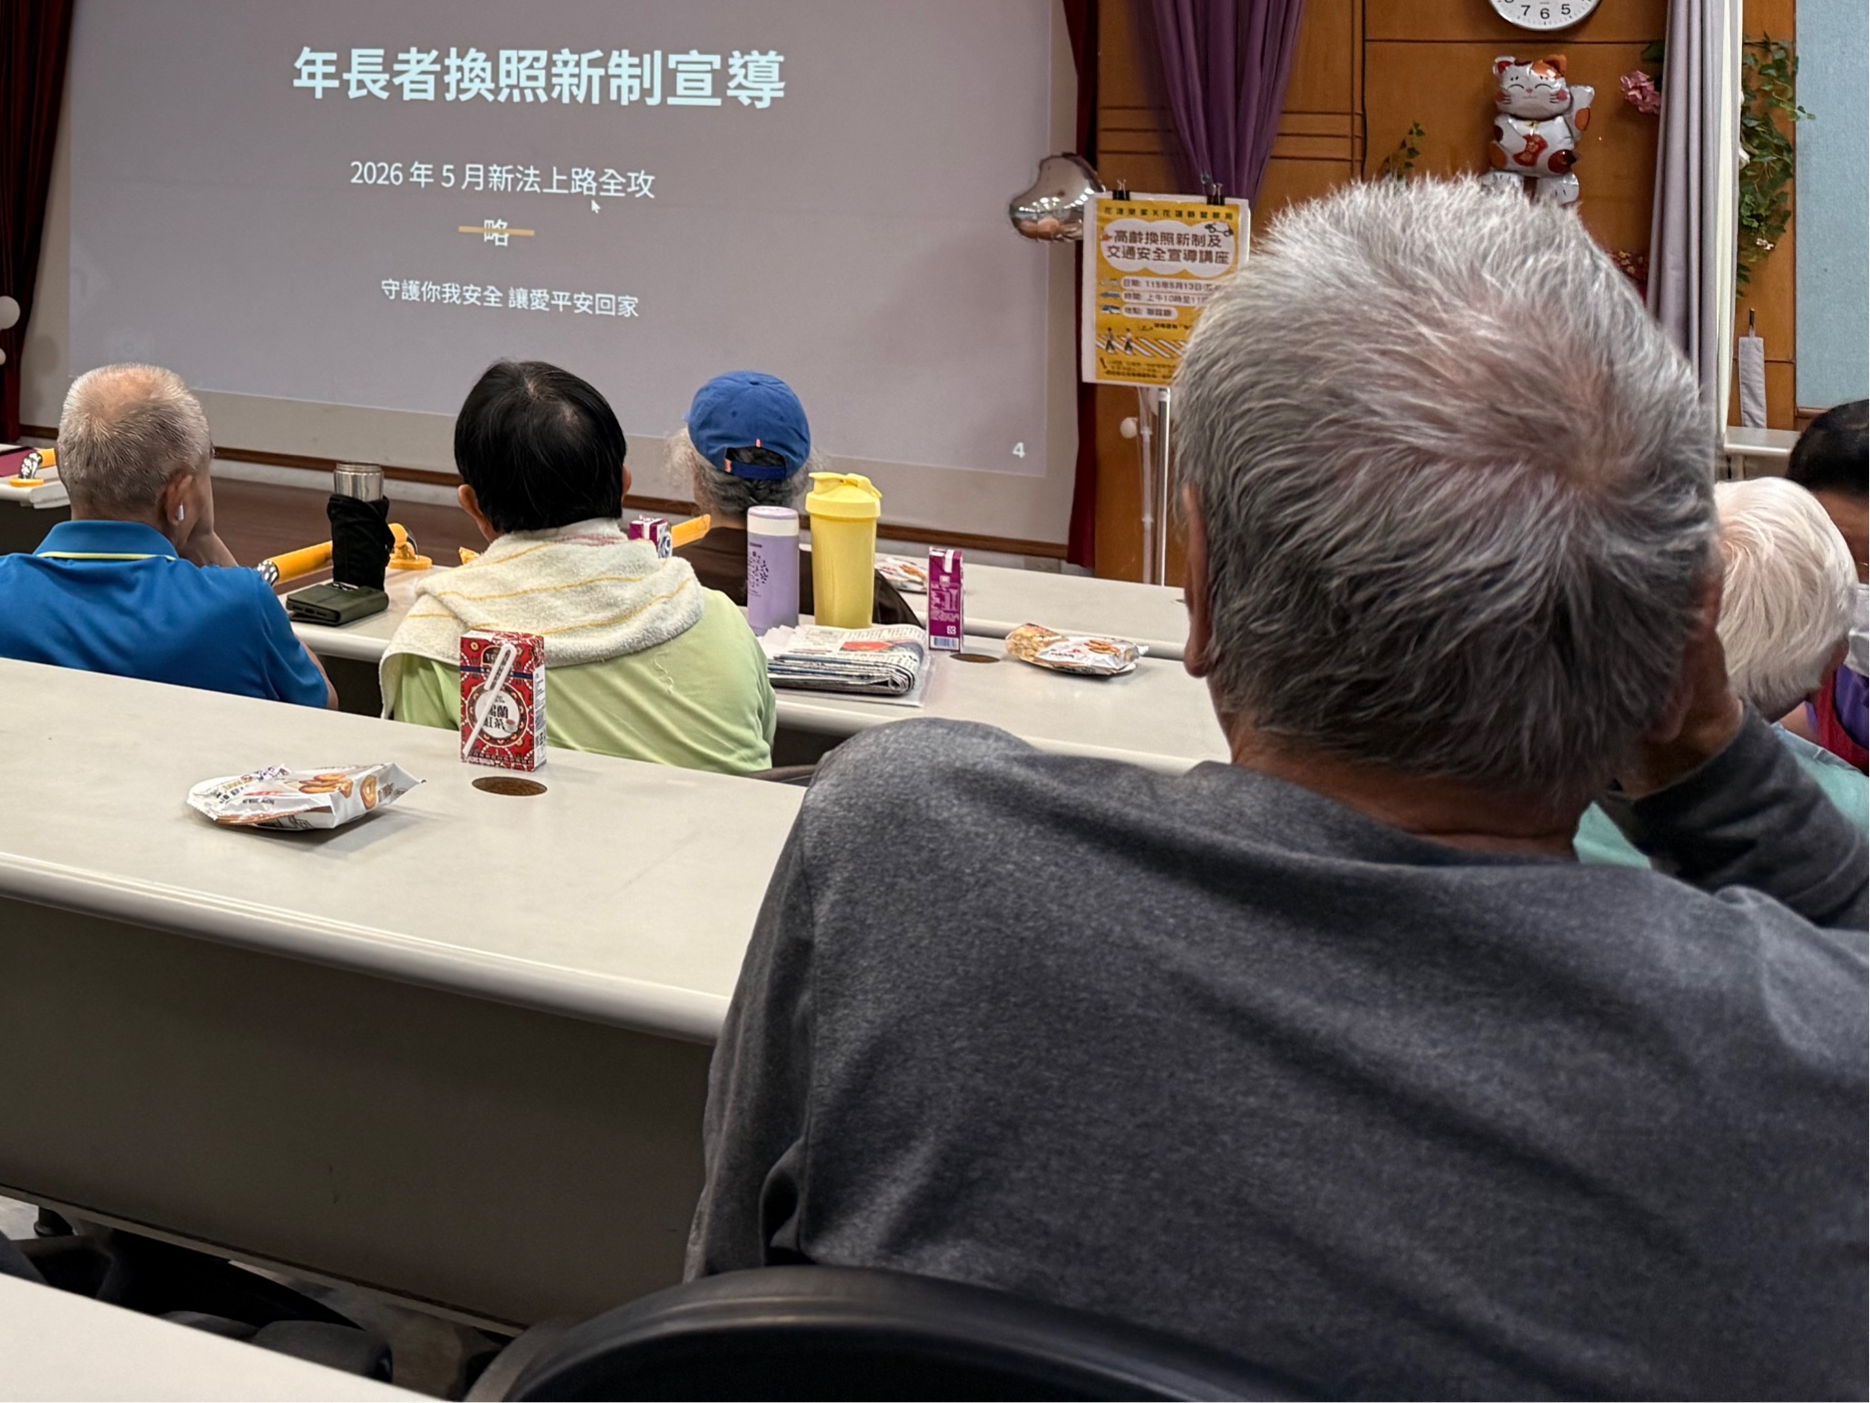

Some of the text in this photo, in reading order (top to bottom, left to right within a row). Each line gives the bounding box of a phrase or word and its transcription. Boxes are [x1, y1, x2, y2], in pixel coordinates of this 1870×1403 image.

[1521, 5, 1531, 16] 7
[1540, 7, 1550, 19] 6
[1561, 4, 1571, 15] 5
[293, 47, 786, 109] 年長者換照新制宣導
[350, 161, 655, 199] 2026 年 5 月新法上路全攻
[484, 219, 509, 246] 略
[1114, 229, 1222, 248] 高齡換照新制及
[1106, 245, 1231, 265] 交通安全宣導講座
[382, 279, 638, 317] 守護你我安全 讓愛平安回家
[1013, 442, 1026, 459] 4
